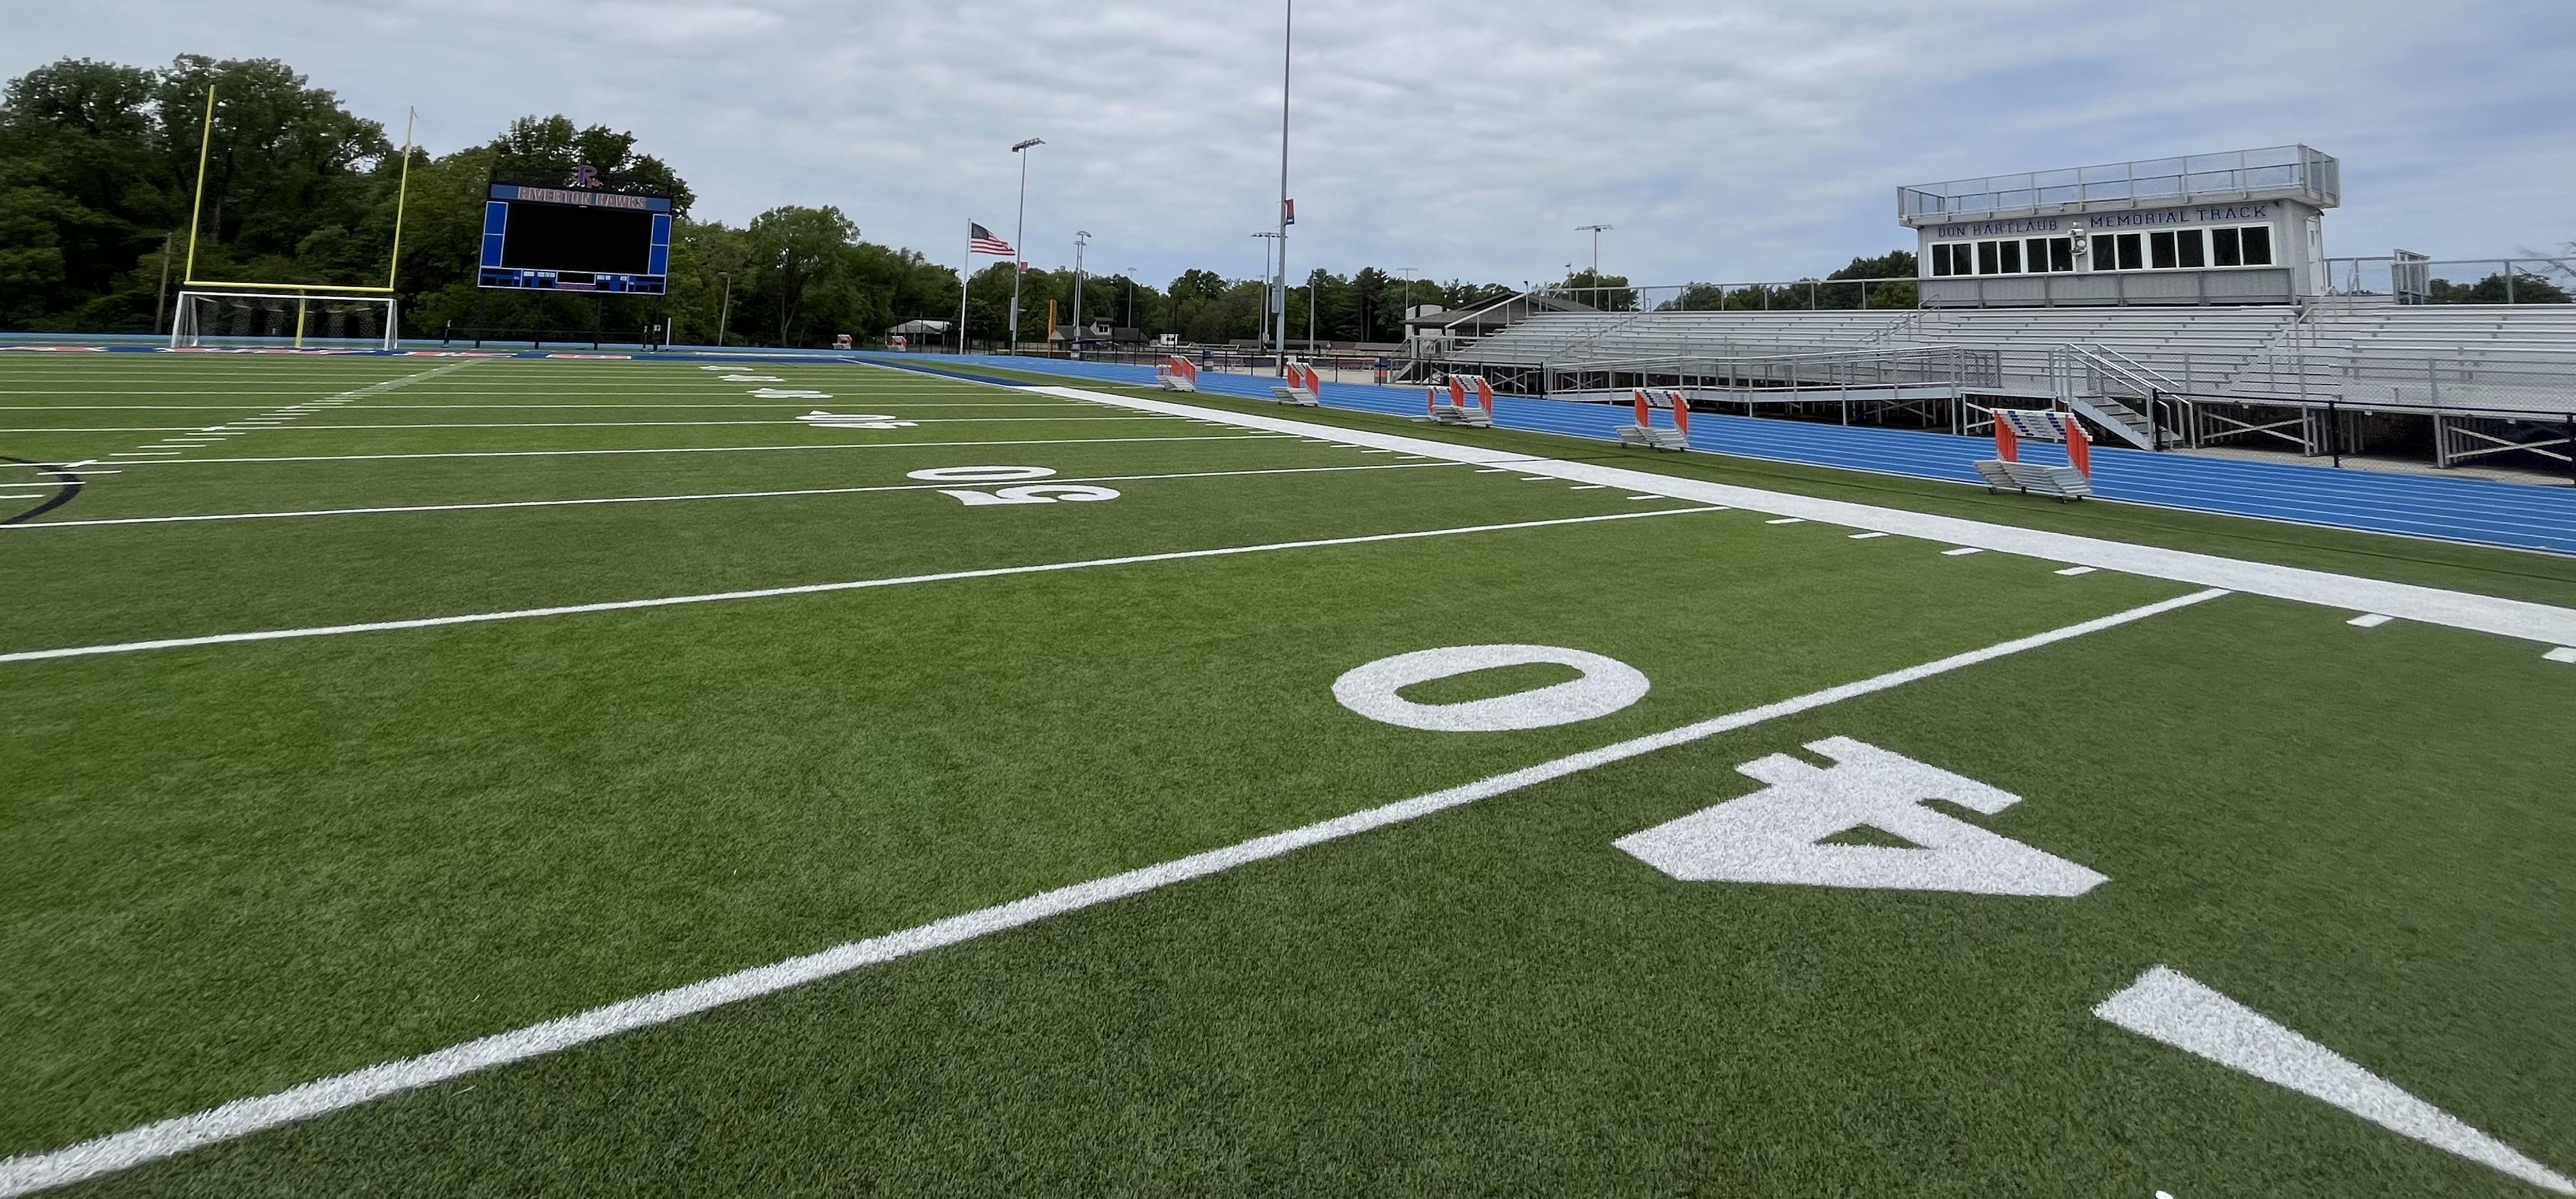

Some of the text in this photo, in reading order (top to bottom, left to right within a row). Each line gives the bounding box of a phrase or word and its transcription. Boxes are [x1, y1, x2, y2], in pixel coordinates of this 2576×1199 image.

[518, 187, 647, 209] RIVERTON HAWKS
[1938, 206, 2267, 237] DON HARTLAUB MEMORIAL TRACK
[907, 466, 1120, 505] 50
